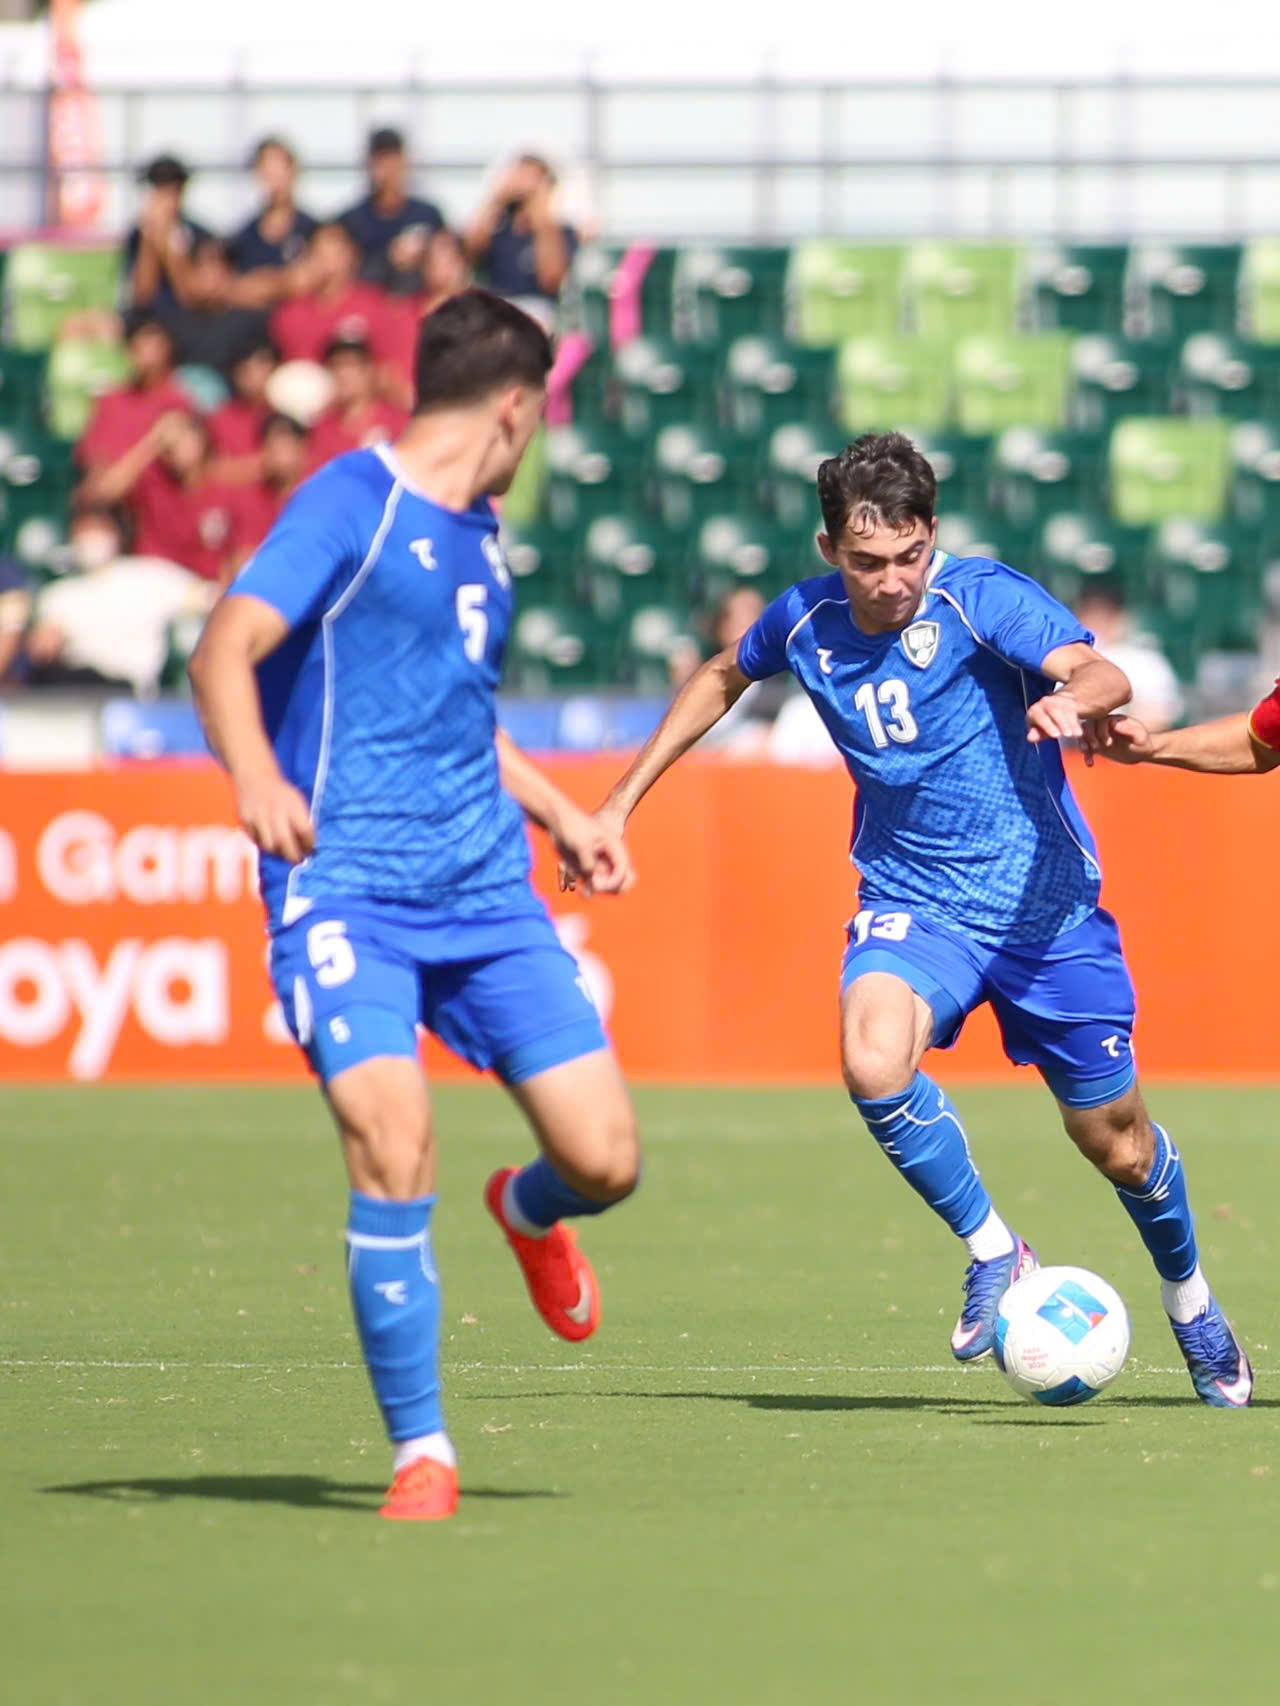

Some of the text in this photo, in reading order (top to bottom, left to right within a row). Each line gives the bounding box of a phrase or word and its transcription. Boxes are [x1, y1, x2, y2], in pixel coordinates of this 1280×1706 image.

[455, 583, 489, 665] 5
[854, 679, 918, 749] 13
[306, 919, 357, 990] 5
[853, 909, 913, 948] 13
[327, 1015, 352, 1045] 5
